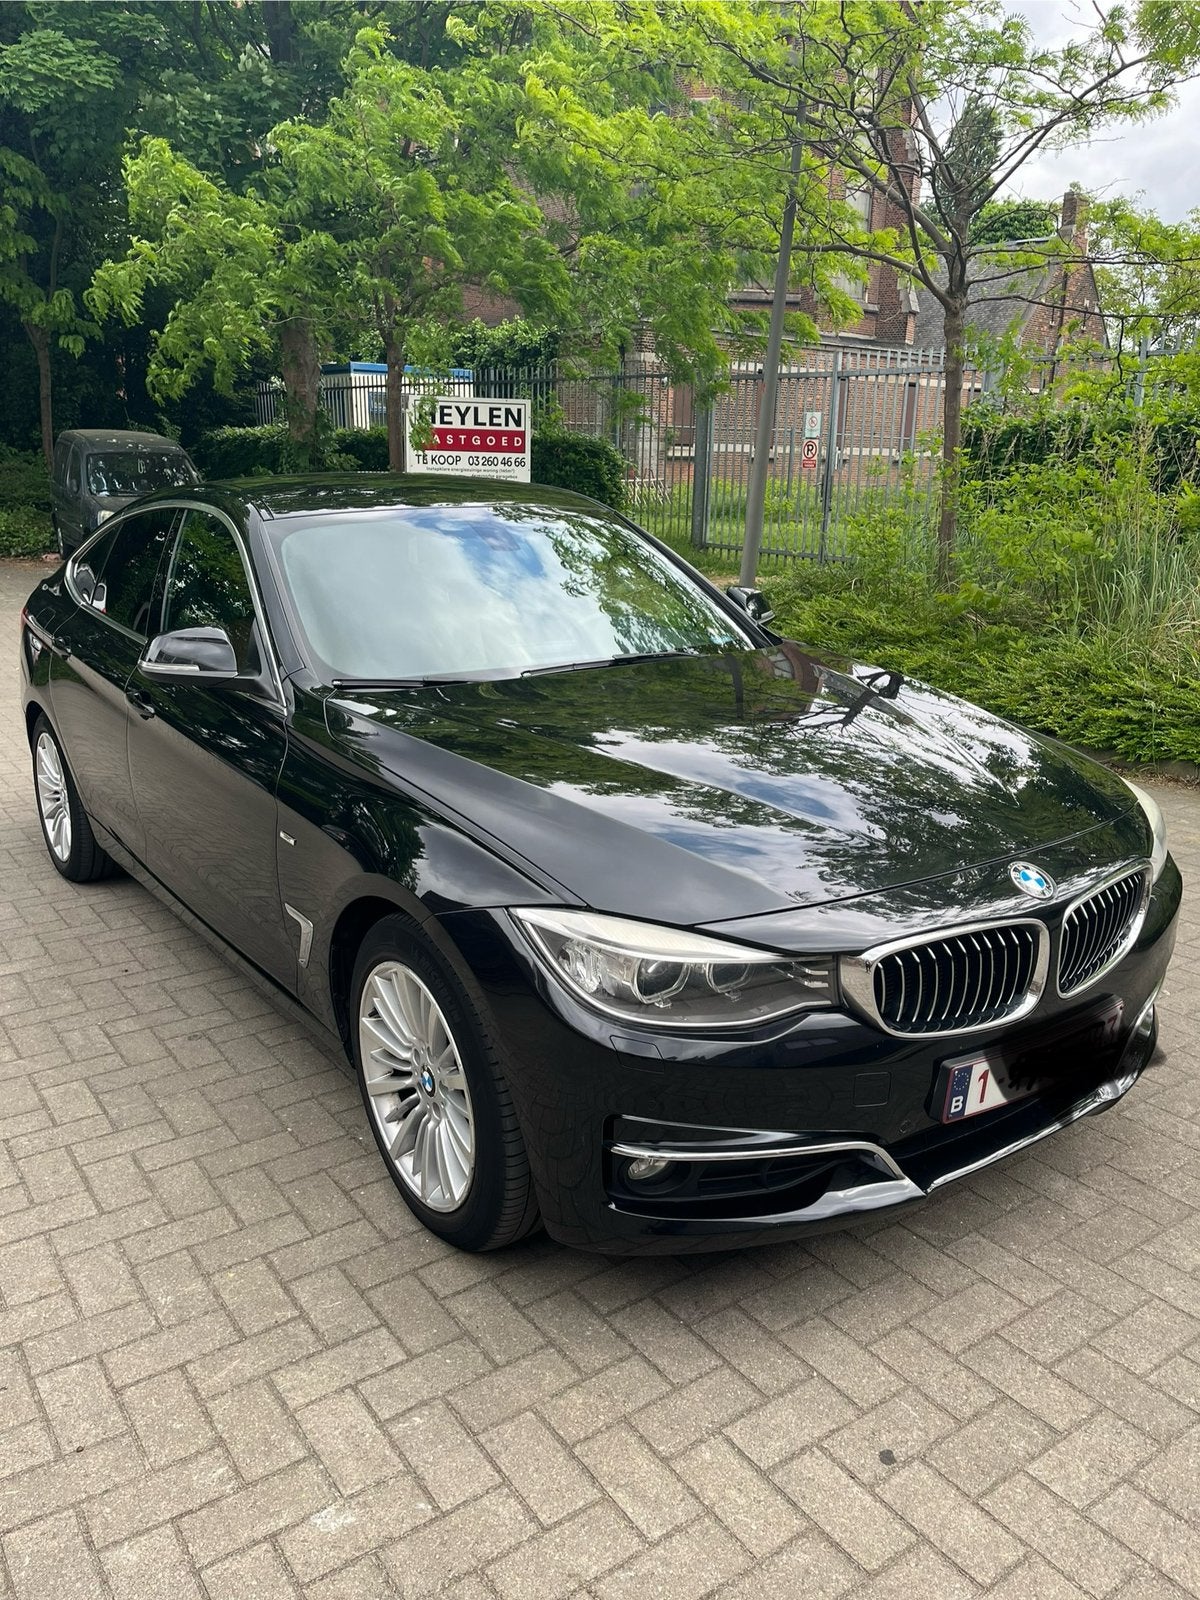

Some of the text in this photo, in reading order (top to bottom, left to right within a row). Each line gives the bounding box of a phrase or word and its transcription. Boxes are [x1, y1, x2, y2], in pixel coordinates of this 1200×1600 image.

[420, 434, 522, 446] ASTGOED
[415, 454, 526, 467] TE KOOP 03 260 46 66
[950, 1096, 964, 1114] B
